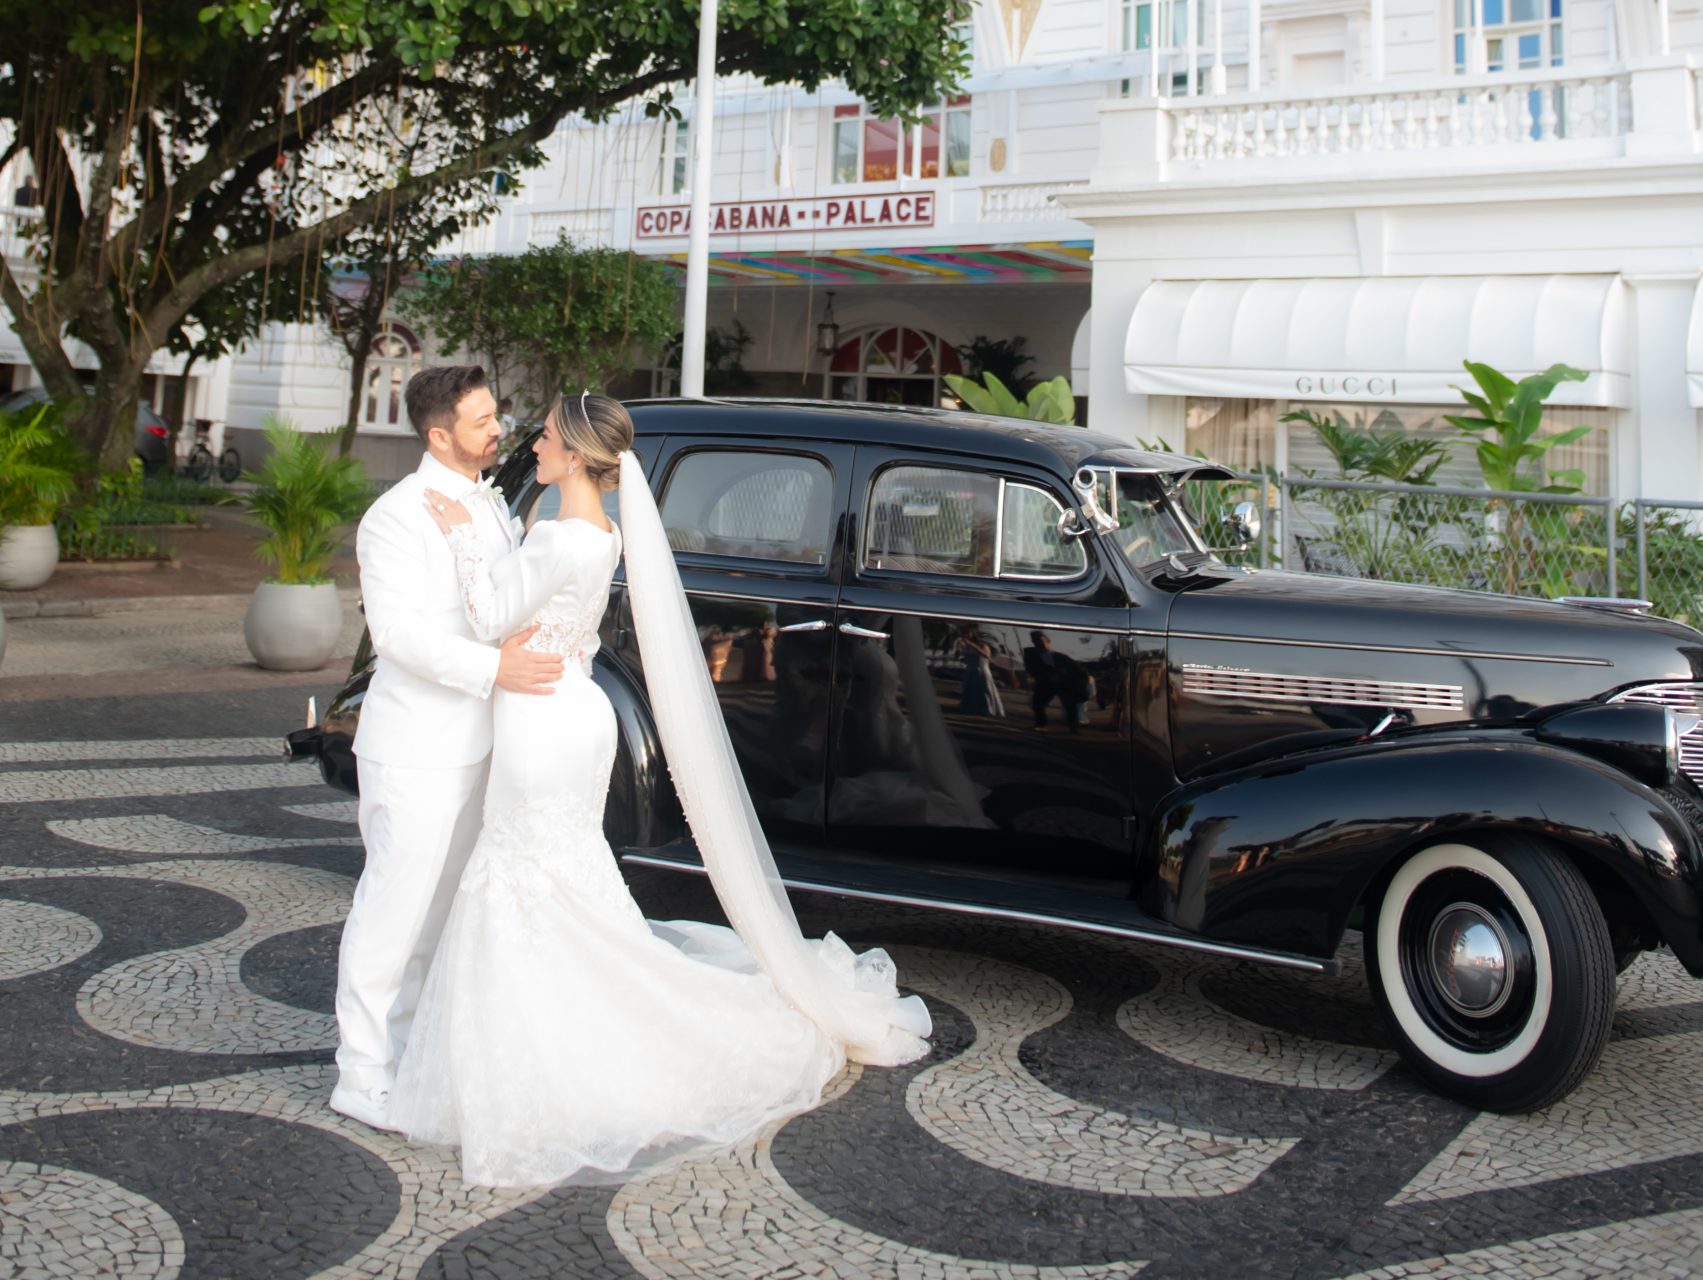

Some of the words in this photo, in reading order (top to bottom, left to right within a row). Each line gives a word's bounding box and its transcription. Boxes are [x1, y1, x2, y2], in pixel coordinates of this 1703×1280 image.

[641, 205, 791, 233] COPAABANA
[826, 197, 931, 226] PALACE
[1296, 376, 1396, 396] GUCCI
